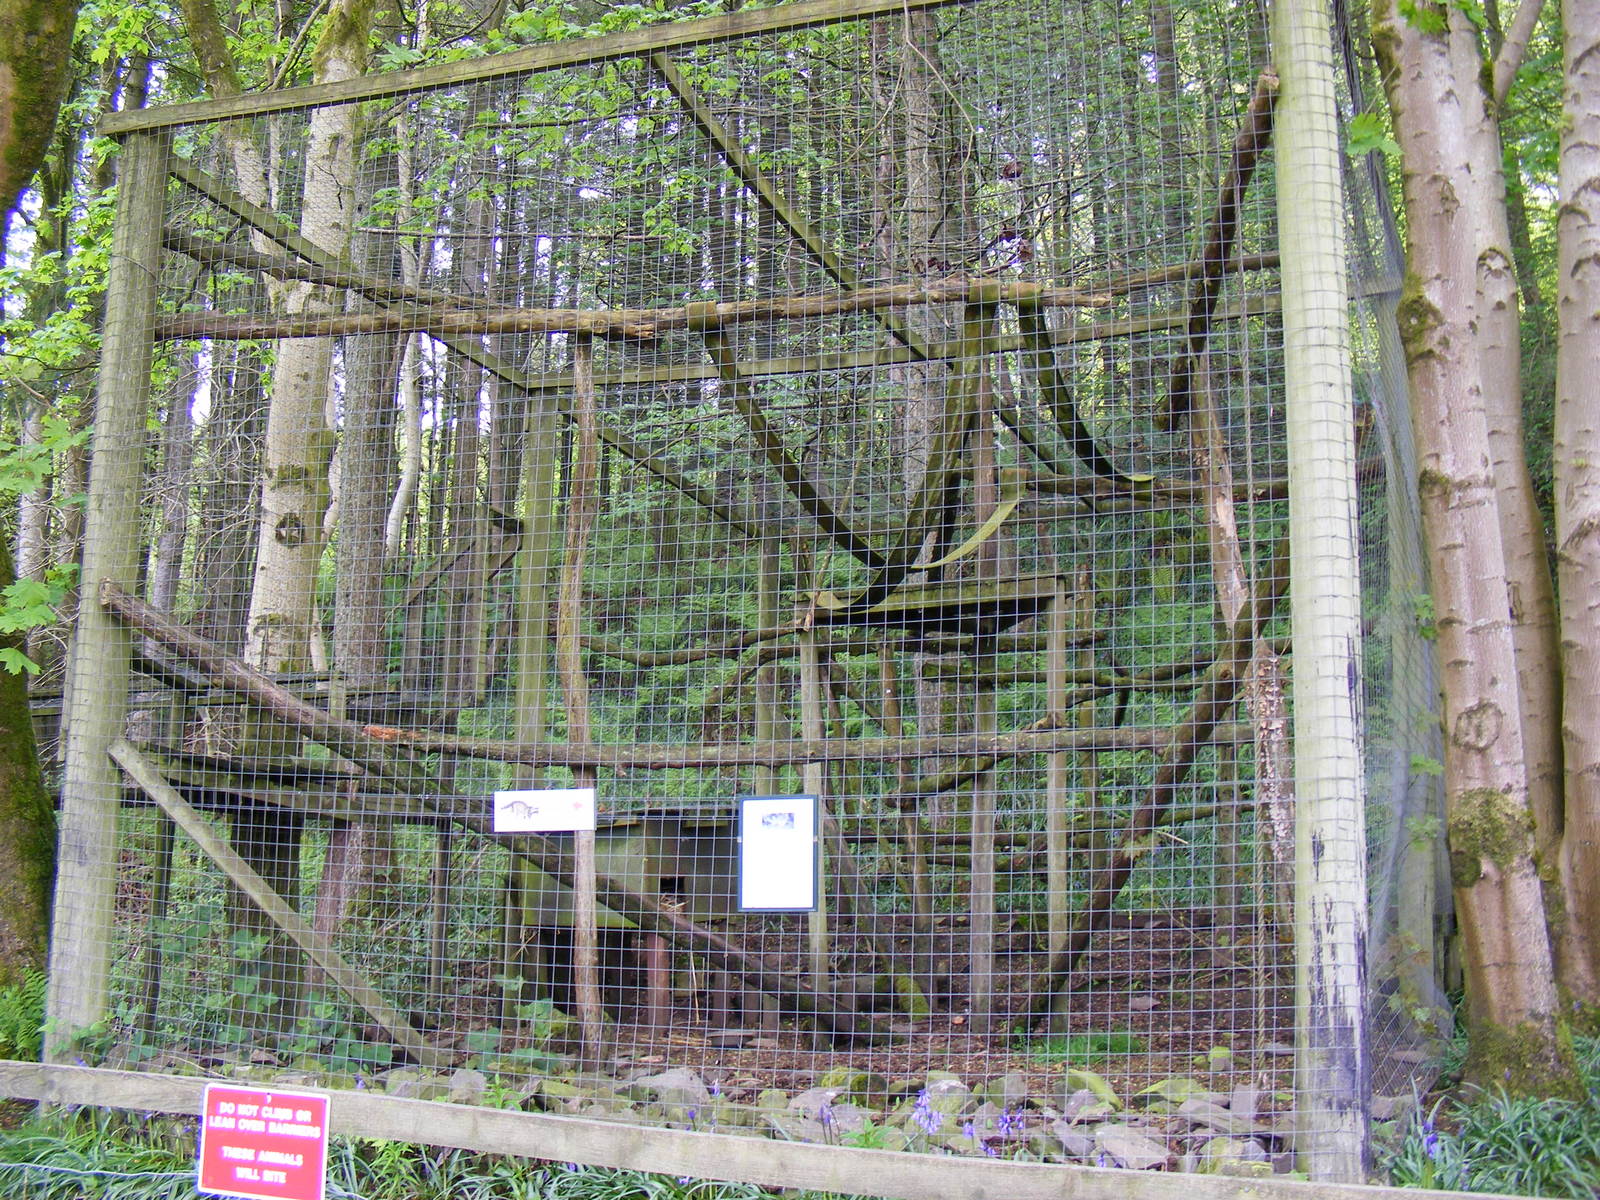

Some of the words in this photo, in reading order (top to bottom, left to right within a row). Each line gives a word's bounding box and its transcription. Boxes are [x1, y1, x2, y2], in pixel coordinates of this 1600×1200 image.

[219, 1102, 235, 1114] DO
[238, 1104, 259, 1116] NOT
[296, 1109, 312, 1122] OR
[209, 1115, 235, 1128] LEAN
[238, 1118, 265, 1132] OVER
[236, 1167, 260, 1180] WILL
[262, 1170, 287, 1184] BITE
